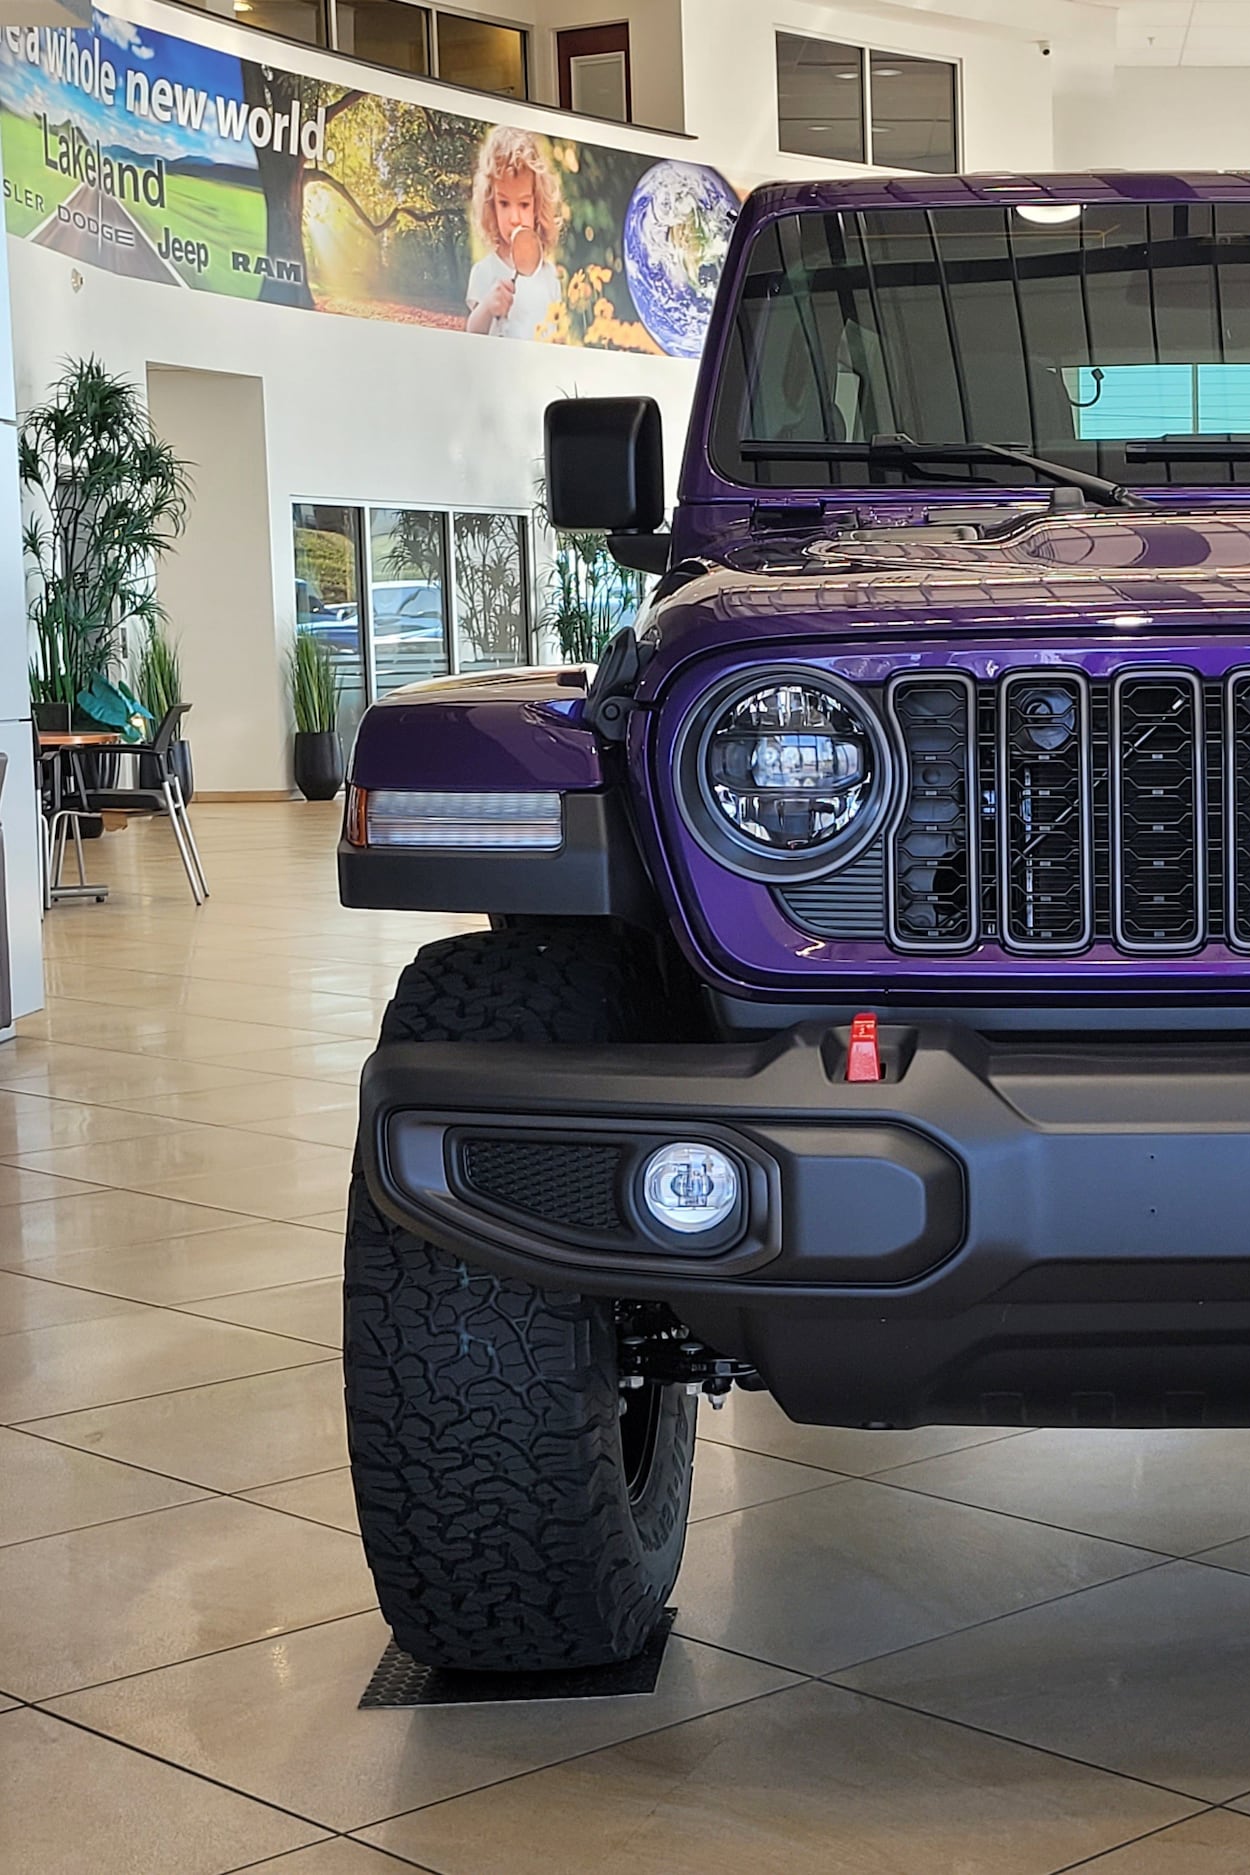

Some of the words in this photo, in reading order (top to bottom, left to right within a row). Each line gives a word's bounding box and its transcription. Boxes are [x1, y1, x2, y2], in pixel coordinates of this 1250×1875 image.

[46, 27, 115, 105] whole
[126, 69, 208, 130] new
[216, 96, 335, 164] world.
[41, 112, 165, 208] Lakeland
[3, 178, 45, 213] SLER
[57, 204, 135, 247] DODGE
[157, 227, 209, 272] Jeep
[232, 251, 302, 282] RAM
